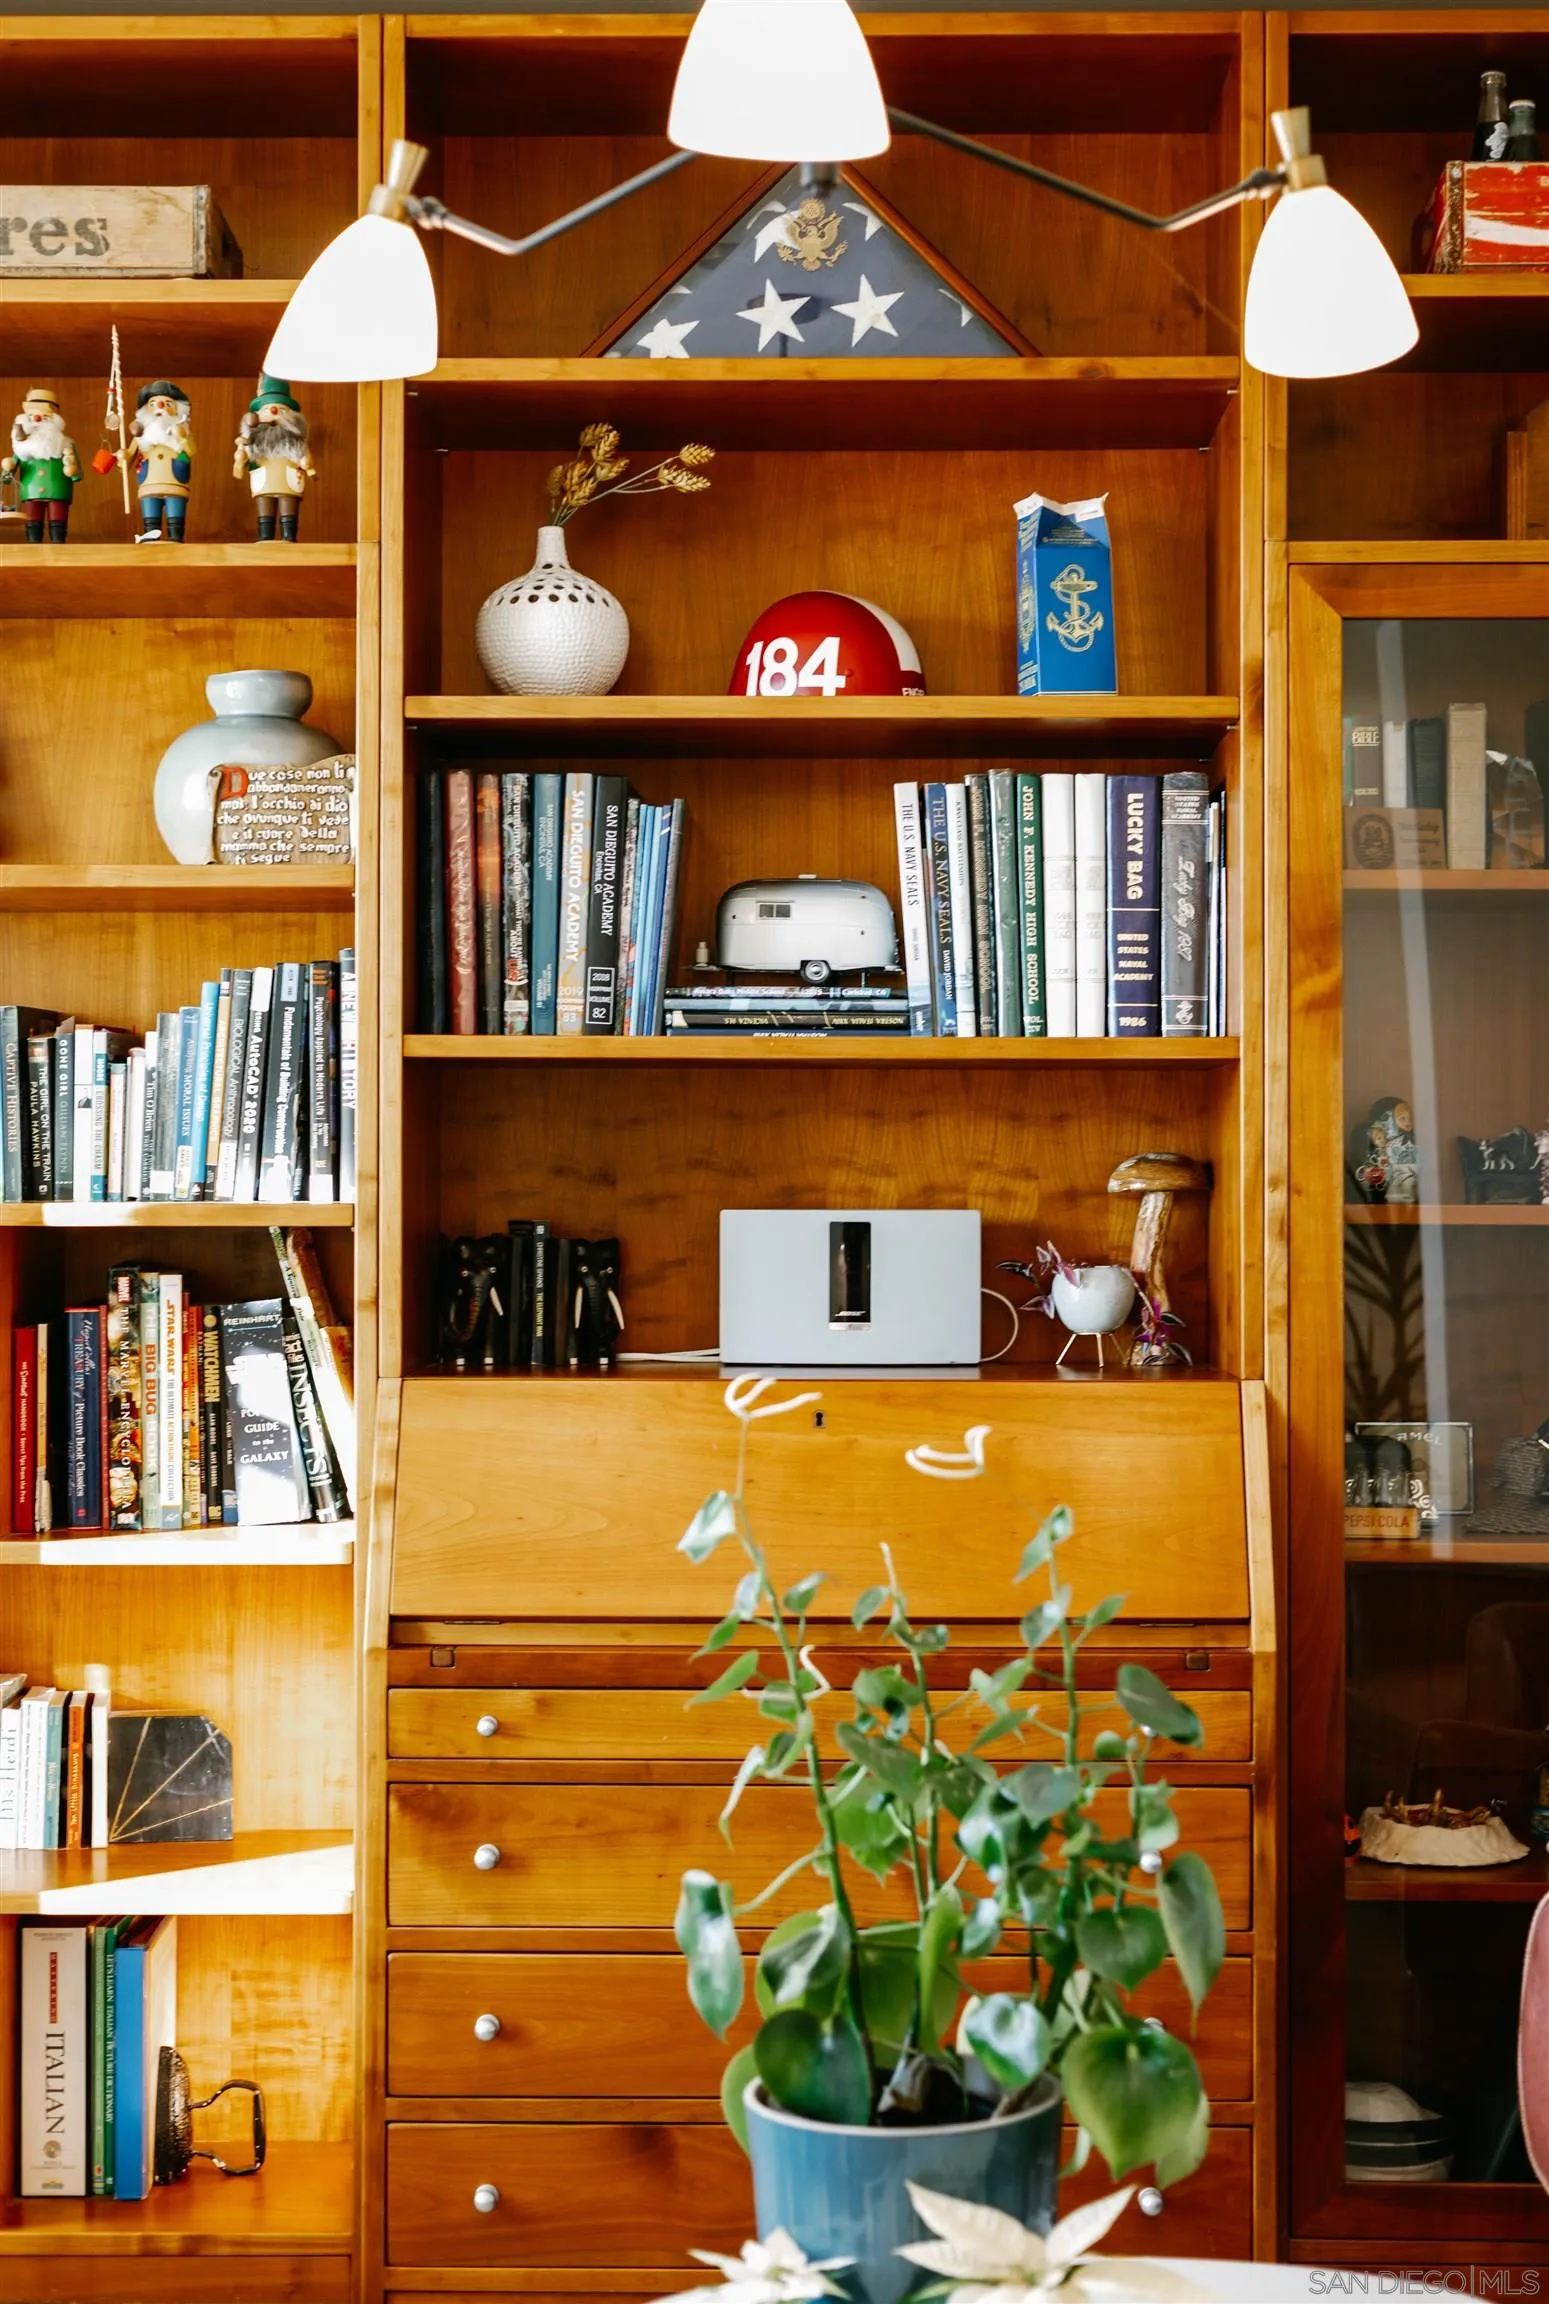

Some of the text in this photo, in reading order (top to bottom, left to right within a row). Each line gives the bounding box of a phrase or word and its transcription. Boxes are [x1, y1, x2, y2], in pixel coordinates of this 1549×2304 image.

[745, 637, 847, 696] 184
[268, 770, 303, 781] cose
[306, 770, 331, 780] non
[333, 761, 346, 779] ti
[216, 812, 240, 825] che
[301, 811, 313, 825] ti
[250, 853, 292, 864] segue
[269, 840, 295, 851] che
[299, 843, 350, 854] sempre
[901, 803, 920, 906] THE U.S. NAVY SEALS
[1126, 793, 1144, 900] LUCKY BAG
[565, 790, 586, 961] SAN DIEGUITO ACADEMY
[600, 805, 619, 936] SAN DIEGUITO ACADEMY
[932, 798, 953, 1000] THE U.S. NAVY SEALS DAVID JORDAN
[1022, 786, 1039, 1004] JOHN F. KENNEDY HIGH SCHOOL
[1117, 946, 1149, 955] STATES
[1118, 960, 1148, 968] NAVAL
[1113, 973, 1154, 981] ACADEMY
[591, 1007, 607, 1019] 82
[1119, 1017, 1147, 1027] 1986
[231, 1018, 245, 1074] BIOLOGICAL
[281, 1006, 296, 1060] Fundamentals
[59, 1039, 69, 1069] GONE
[280, 1061, 292, 1071] of
[313, 996, 326, 1116] Psychology Applied to Modern Life
[5, 1043, 20, 1153] CAPTIVE HISTORIES
[59, 1073, 68, 1097] GIRL
[146, 1080, 156, 1098] Tim
[183, 1074, 195, 1106] MORAL
[277, 1071, 291, 1103] Building
[39, 1067, 51, 1181] THE GIRL ON THE TRAIN
[59, 1100, 68, 1138] GILLIAN
[182, 1108, 193, 1137] ISSUES
[224, 1078, 239, 1137] Anthropology
[244, 1100, 258, 1134] 2020
[30, 1081, 41, 1168] PAULA HAWKINS
[274, 1103, 289, 1154] Construction
[116, 1276, 131, 1302] MARVEL
[166, 1299, 176, 1338] STAR
[224, 1313, 282, 1326] REINHART
[73, 1336, 85, 1390] TREASURY
[119, 1340, 131, 1393] MARVEL
[166, 1340, 176, 1376] WARS
[203, 1330, 220, 1402] WATCHMEN
[145, 1343, 157, 1415] BIG BUG
[167, 1379, 176, 1389] THE
[20, 1398, 28, 1431] HANDBOOK
[74, 1403, 87, 1435] Picture
[167, 1390, 176, 1419] ULTIMATE
[244, 1421, 280, 1434] GUIDE
[289, 1364, 330, 1479] INSECTS
[74, 1437, 87, 1460] Book
[1394, 1431, 1442, 1446] AMEL
[240, 1450, 288, 1464] GALAXY
[75, 1461, 88, 1497] Classics
[106, 1975, 115, 2002] LEARN
[106, 2005, 115, 2037] ITALIAN
[106, 2041, 115, 2074] PICTURE
[45, 2032, 65, 2134] ITALIAN
[105, 2075, 114, 2123] DICTIONARY
